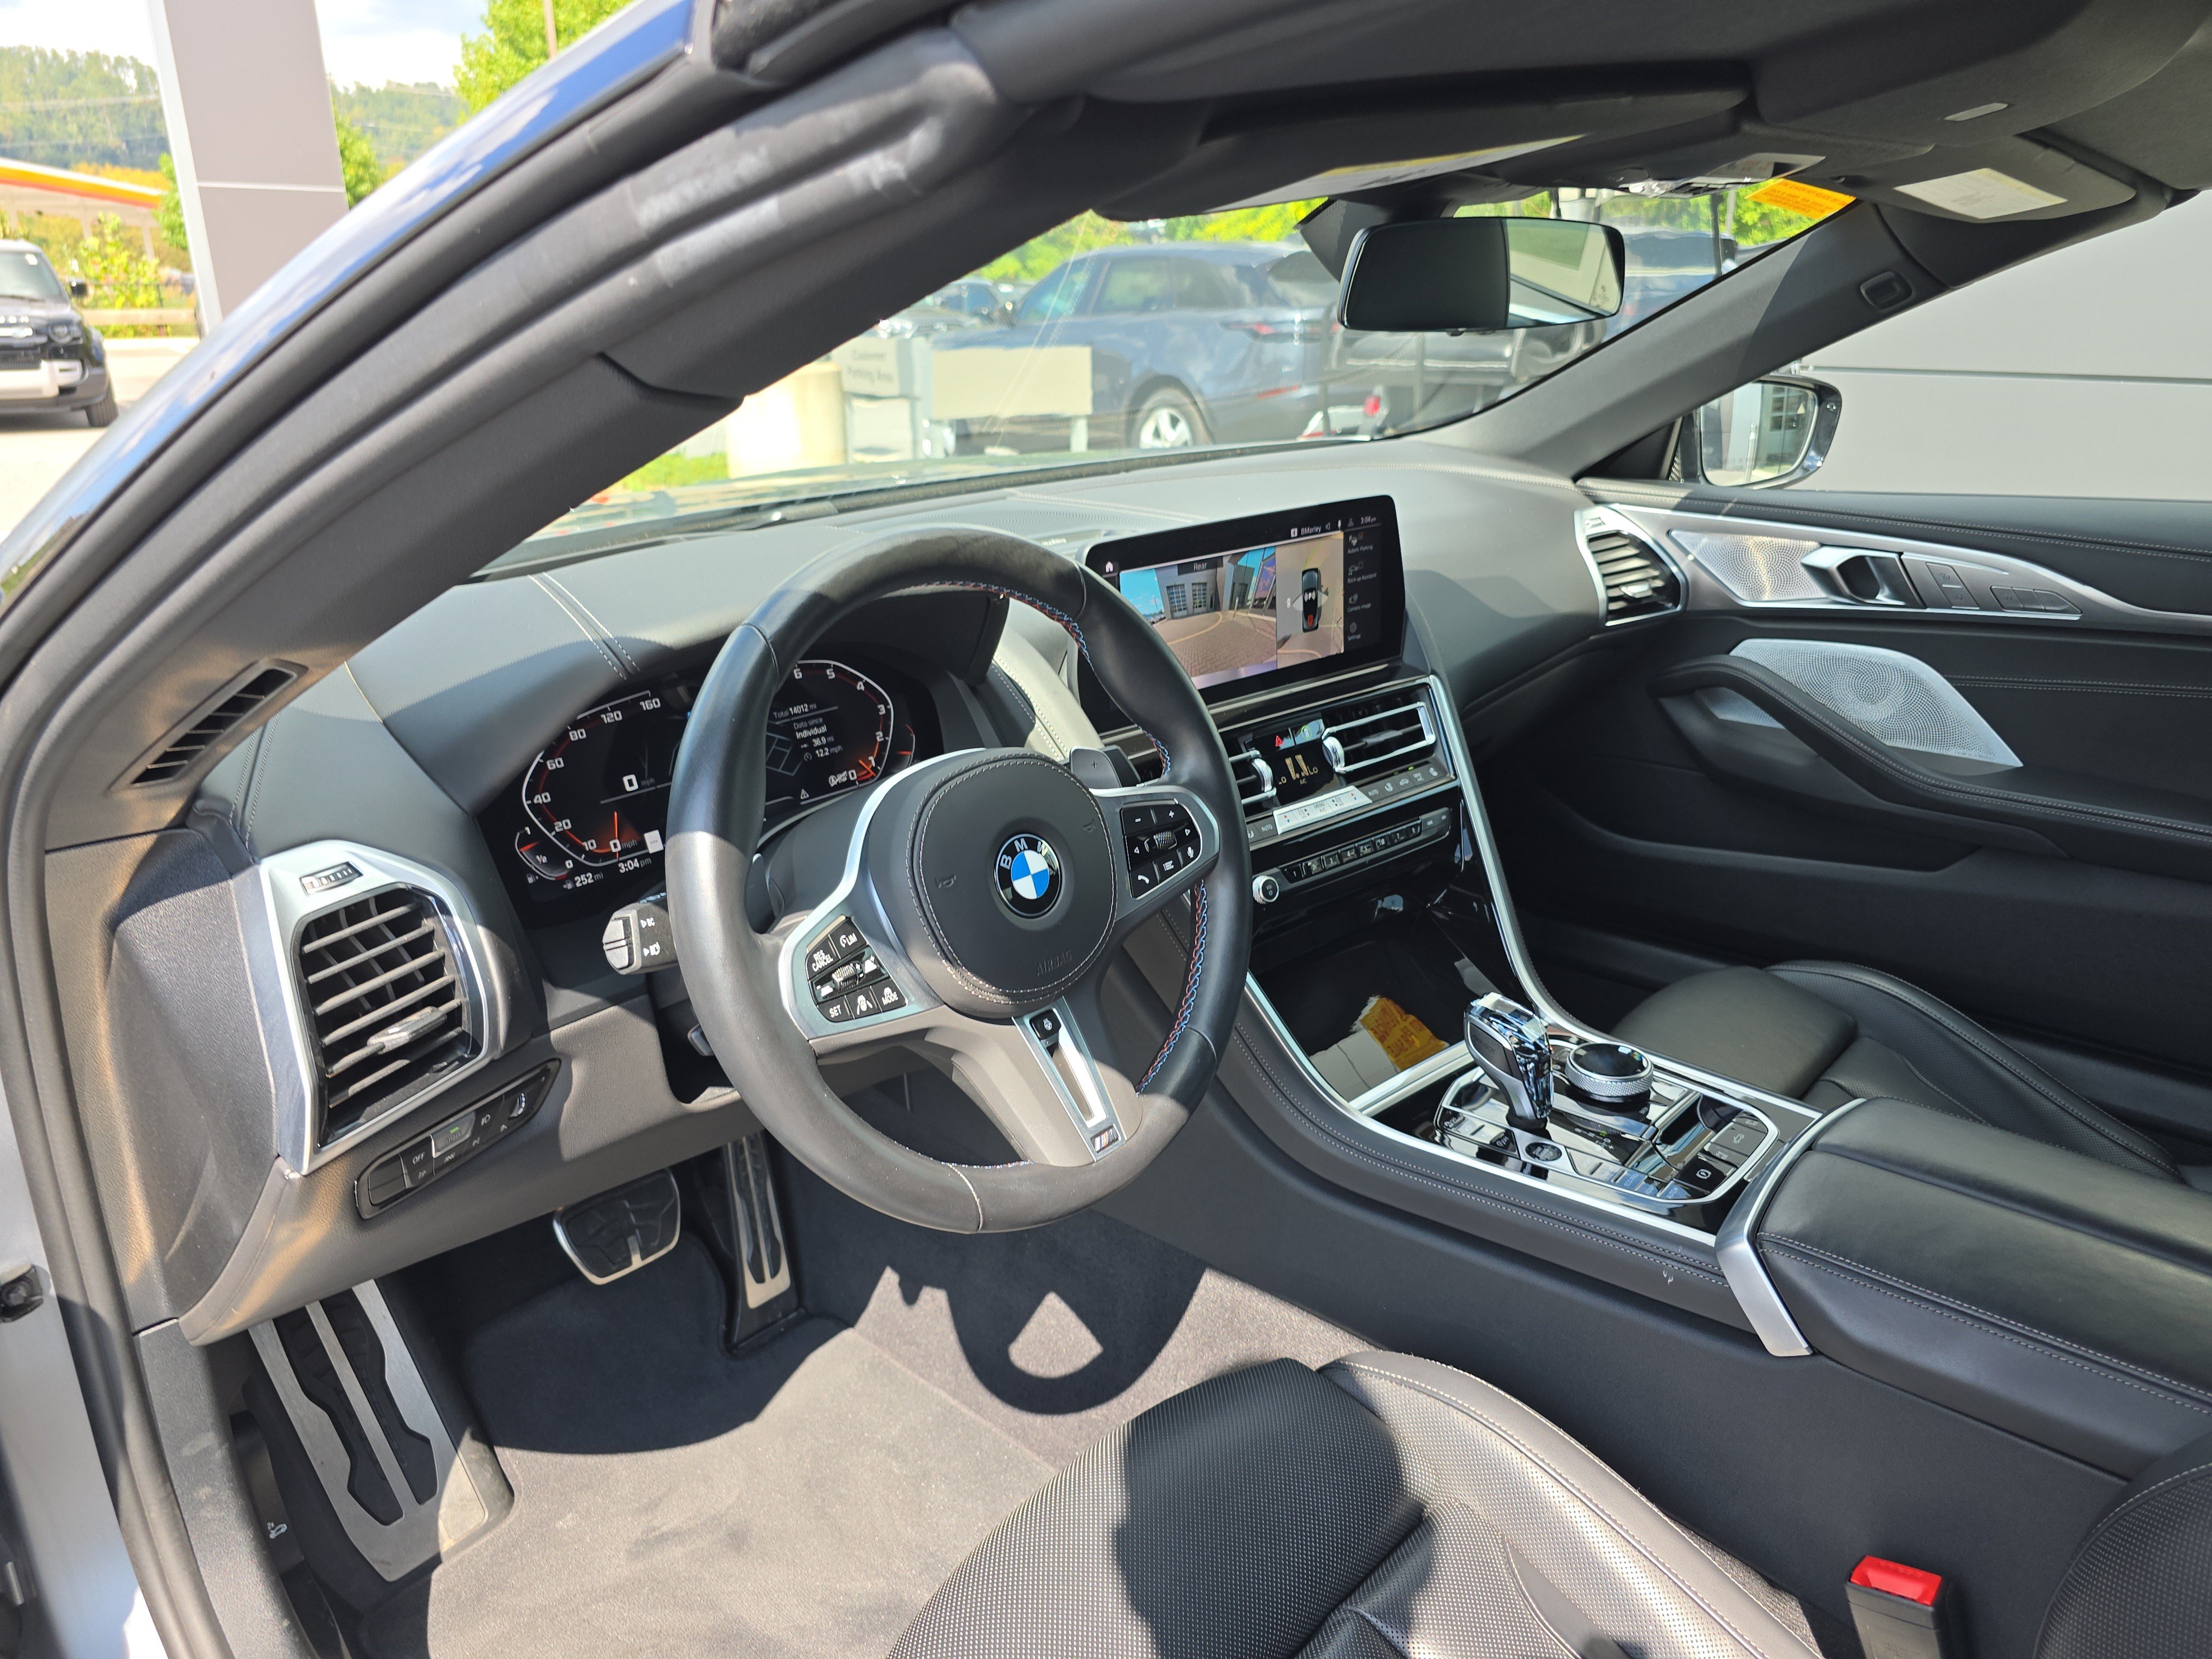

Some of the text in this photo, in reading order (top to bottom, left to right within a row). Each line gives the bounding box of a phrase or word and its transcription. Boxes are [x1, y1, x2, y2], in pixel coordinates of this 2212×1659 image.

[794, 667, 802, 679] 6
[826, 668, 835, 679] 5
[857, 681, 865, 691] 4
[639, 698, 661, 711] 160
[773, 710, 789, 719] Total
[789, 703, 809, 715] 14012
[877, 704, 885, 715] 3
[601, 711, 622, 724] 120
[569, 729, 587, 741] 80
[795, 724, 827, 740] Individual
[876, 731, 884, 742] 2
[815, 747, 830, 758] 12.2
[546, 757, 564, 770] 60
[868, 756, 875, 767] 1
[848, 769, 857, 780] 0
[623, 774, 639, 792] 0
[533, 792, 551, 805] 40
[1368, 788, 1379, 796] AUTO
[554, 819, 572, 832] 20
[1261, 824, 1273, 832] AUTO
[582, 839, 596, 851] 10
[609, 839, 638, 852] 0 mph
[1000, 837, 1049, 870] BMW
[565, 859, 574, 869] 0
[618, 857, 652, 873] 3:04 pm
[575, 872, 594, 888] 252
[846, 933, 857, 946] LIM
[812, 954, 833, 972] CANCEL
[1037, 950, 1072, 976] AIRBAG
[882, 992, 898, 1006] MODE
[829, 1005, 841, 1018] SET
[413, 1152, 426, 1165] OFF
